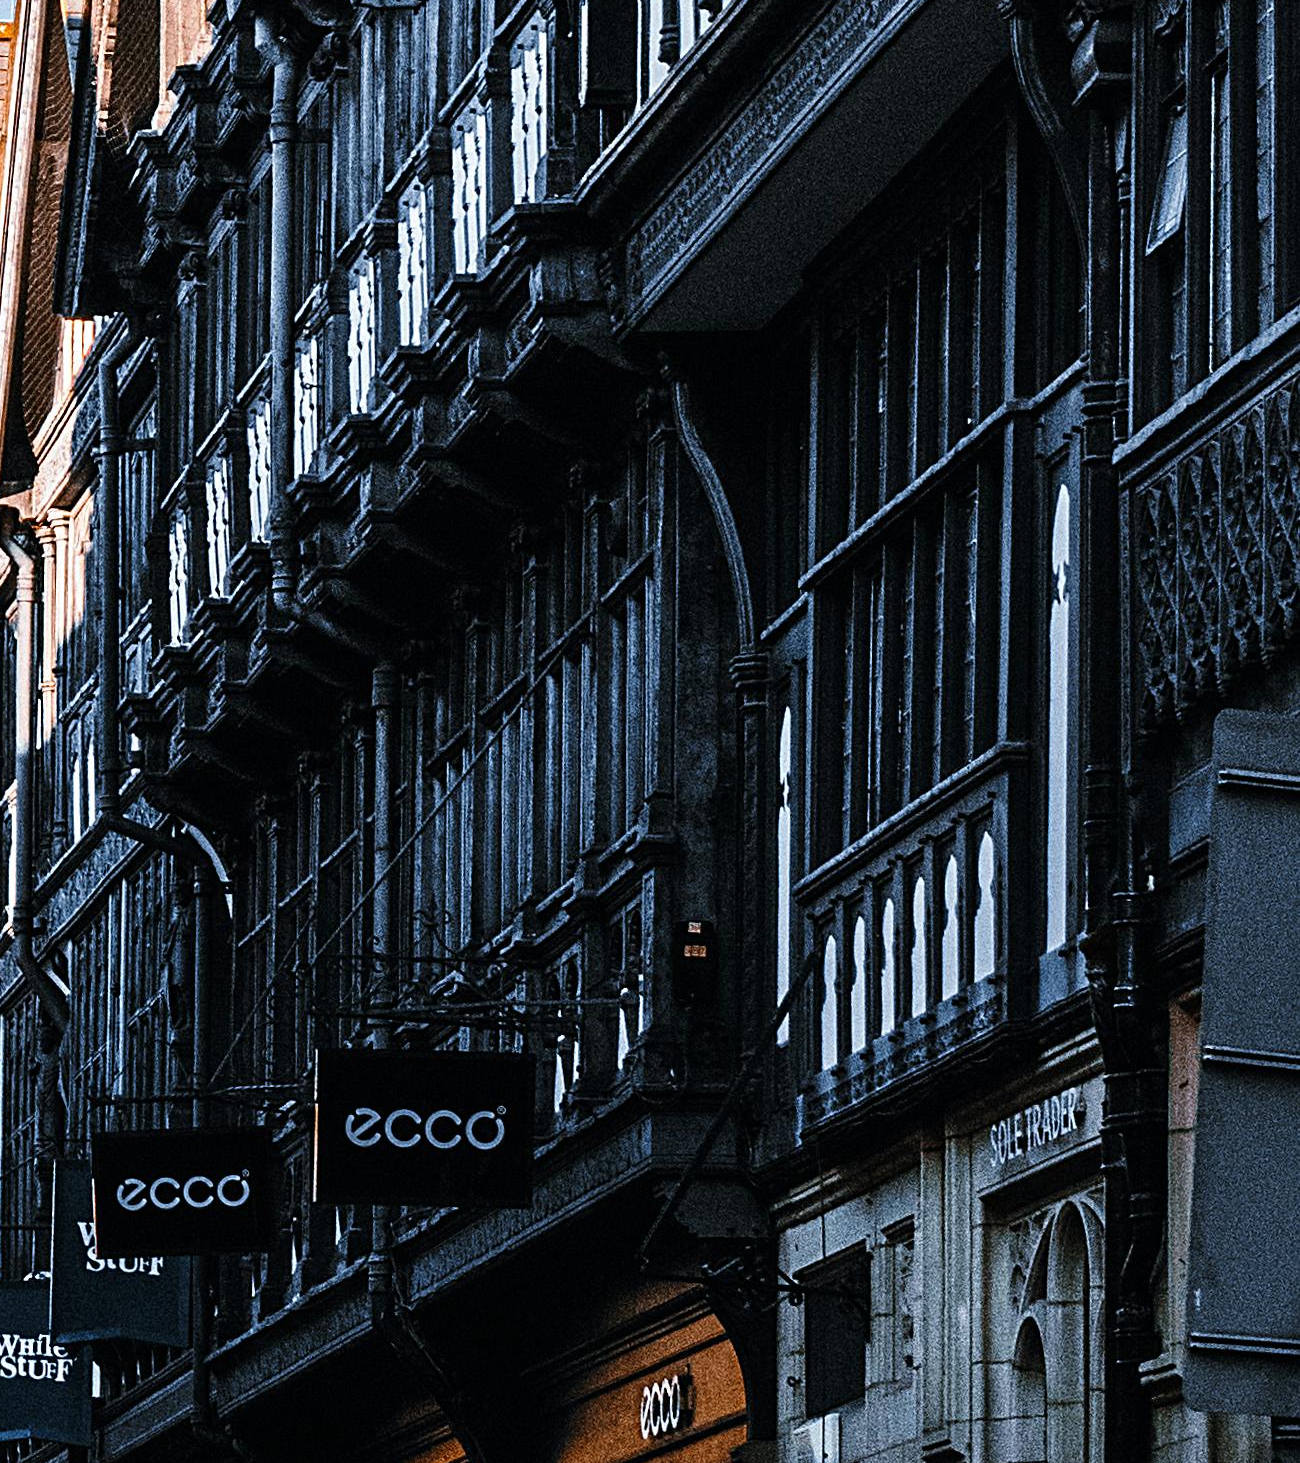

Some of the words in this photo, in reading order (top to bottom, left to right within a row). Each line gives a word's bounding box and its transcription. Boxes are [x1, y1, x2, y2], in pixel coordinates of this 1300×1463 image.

[344, 1107, 506, 1151] ecco
[990, 1110, 1024, 1167] SOLE
[1025, 1086, 1078, 1152] TRADER
[116, 1175, 250, 1211] ecco
[640, 1374, 681, 1440] ecco
